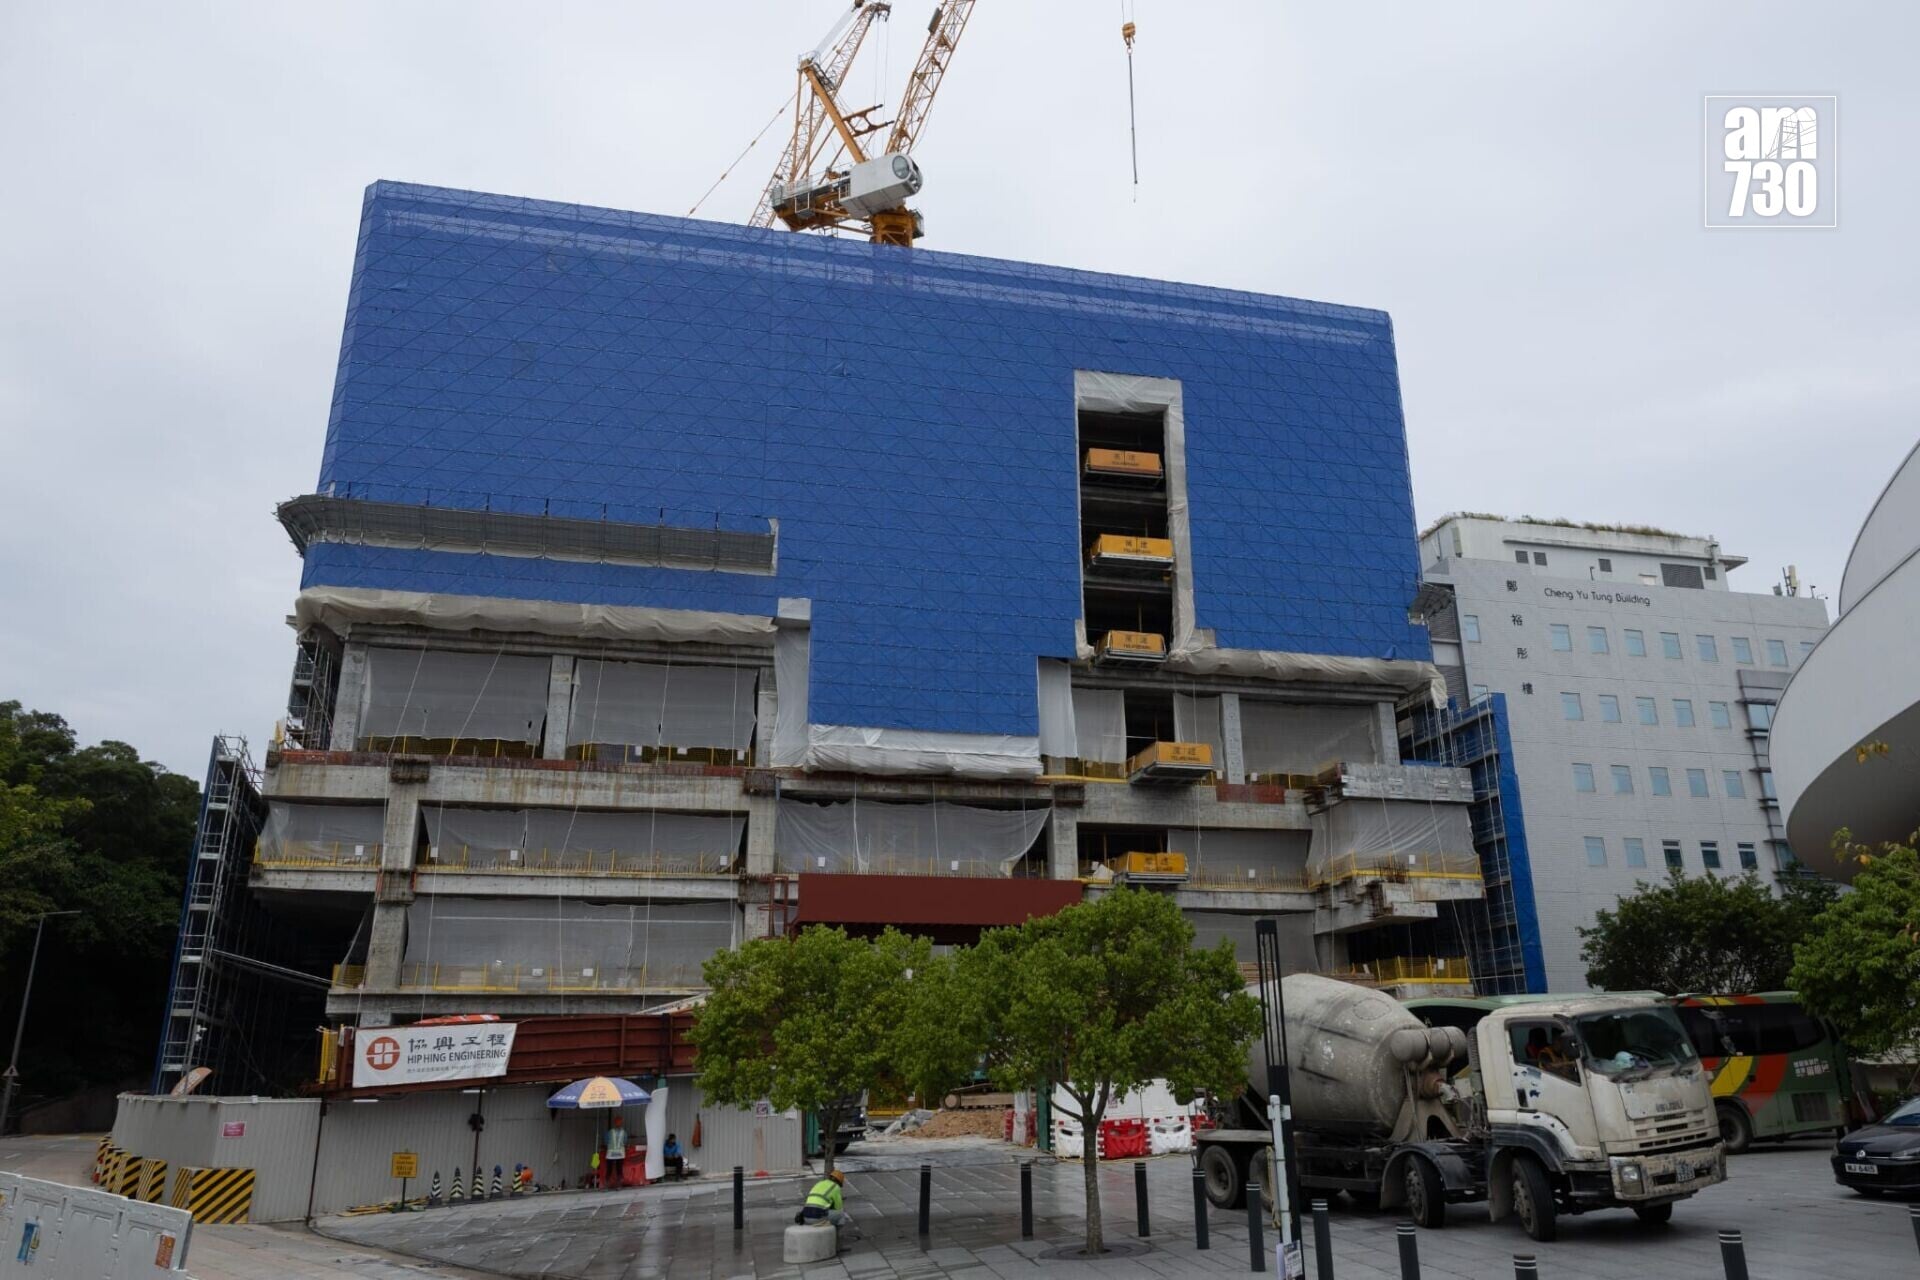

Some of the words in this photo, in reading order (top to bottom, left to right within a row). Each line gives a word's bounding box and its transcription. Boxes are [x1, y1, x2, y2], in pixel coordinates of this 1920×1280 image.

[1544, 587, 1574, 600] Cheng
[1576, 590, 1589, 600] Yu
[1591, 591, 1613, 604] Tung
[1615, 593, 1651, 606] Building
[1506, 580, 1533, 695] 鄭裕彤樓
[448, 1048, 507, 1062] ENGINEERING
